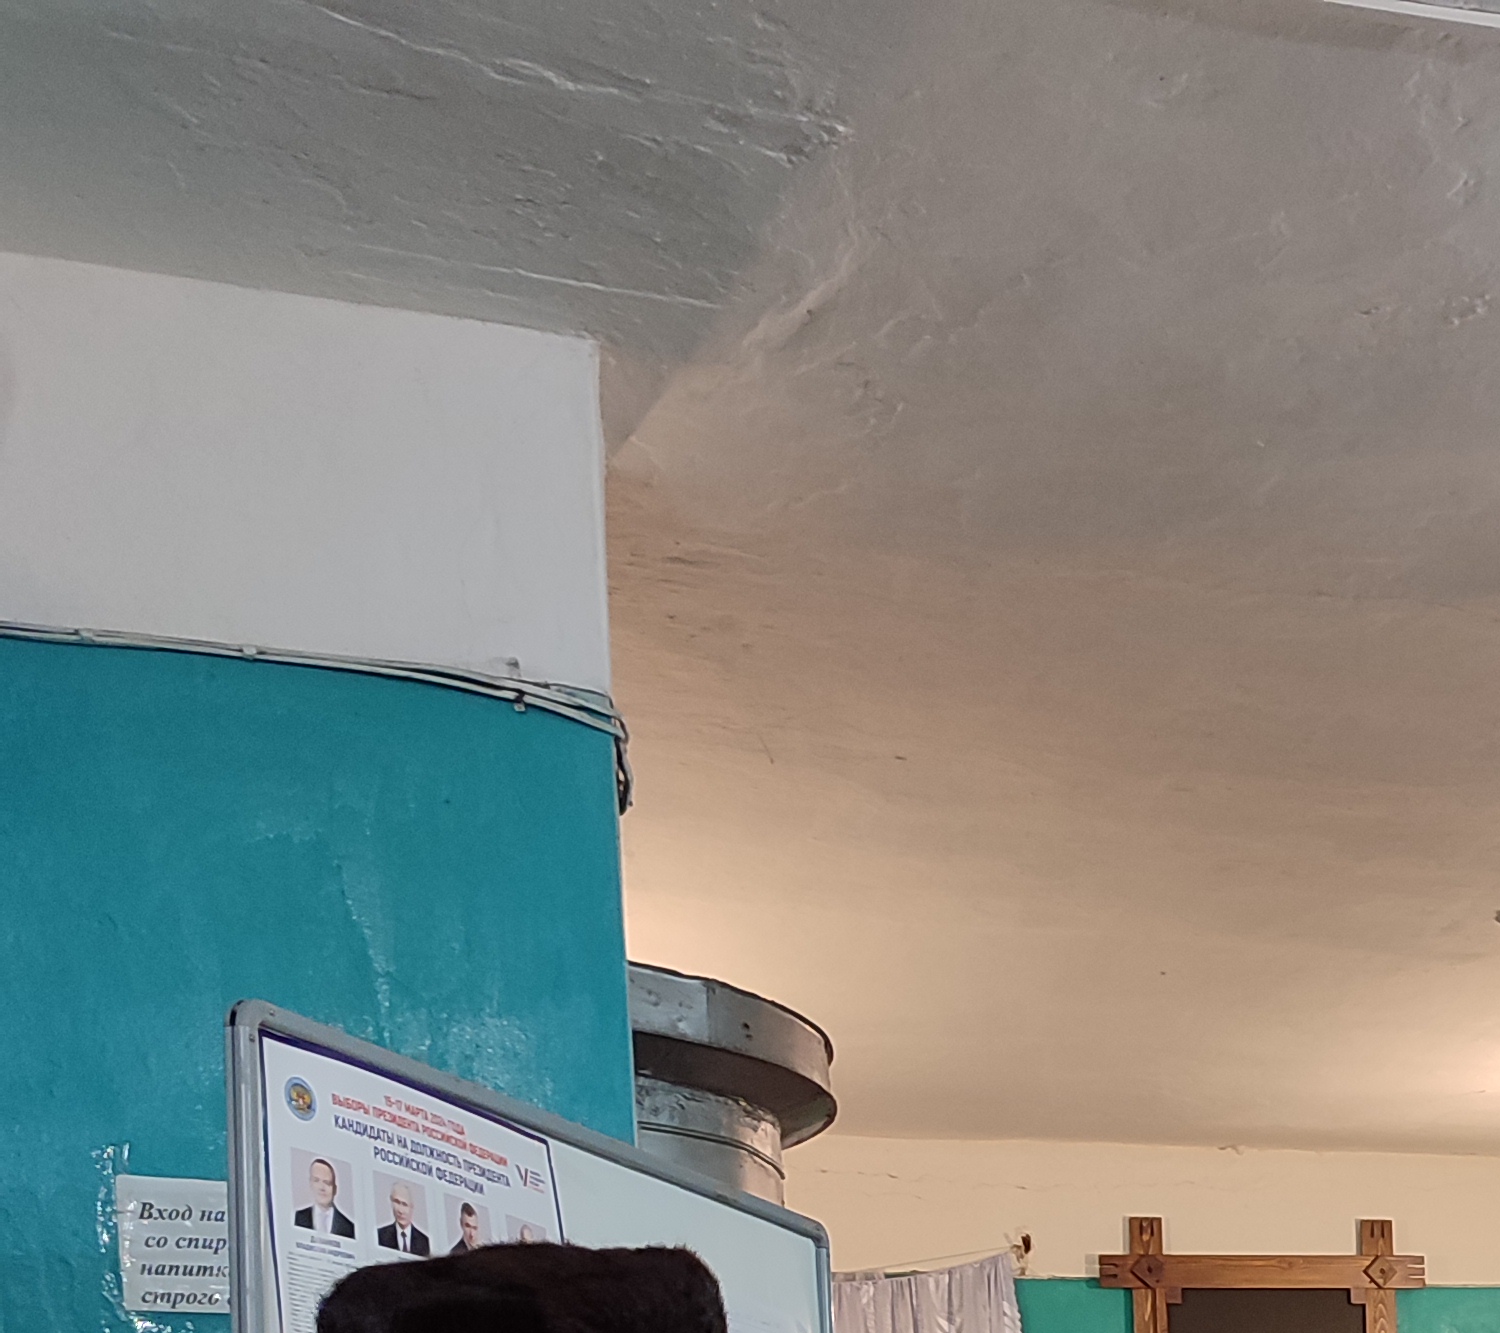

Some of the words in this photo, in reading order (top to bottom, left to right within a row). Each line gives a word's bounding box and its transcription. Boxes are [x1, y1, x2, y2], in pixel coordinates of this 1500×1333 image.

[334, 1114, 396, 1146] КАНДИДАТЫ
[396, 1134, 409, 1150] НА
[139, 1202, 193, 1221] Вход
[199, 1209, 226, 1222] на
[144, 1236, 168, 1248] со
[141, 1290, 221, 1309] строго
